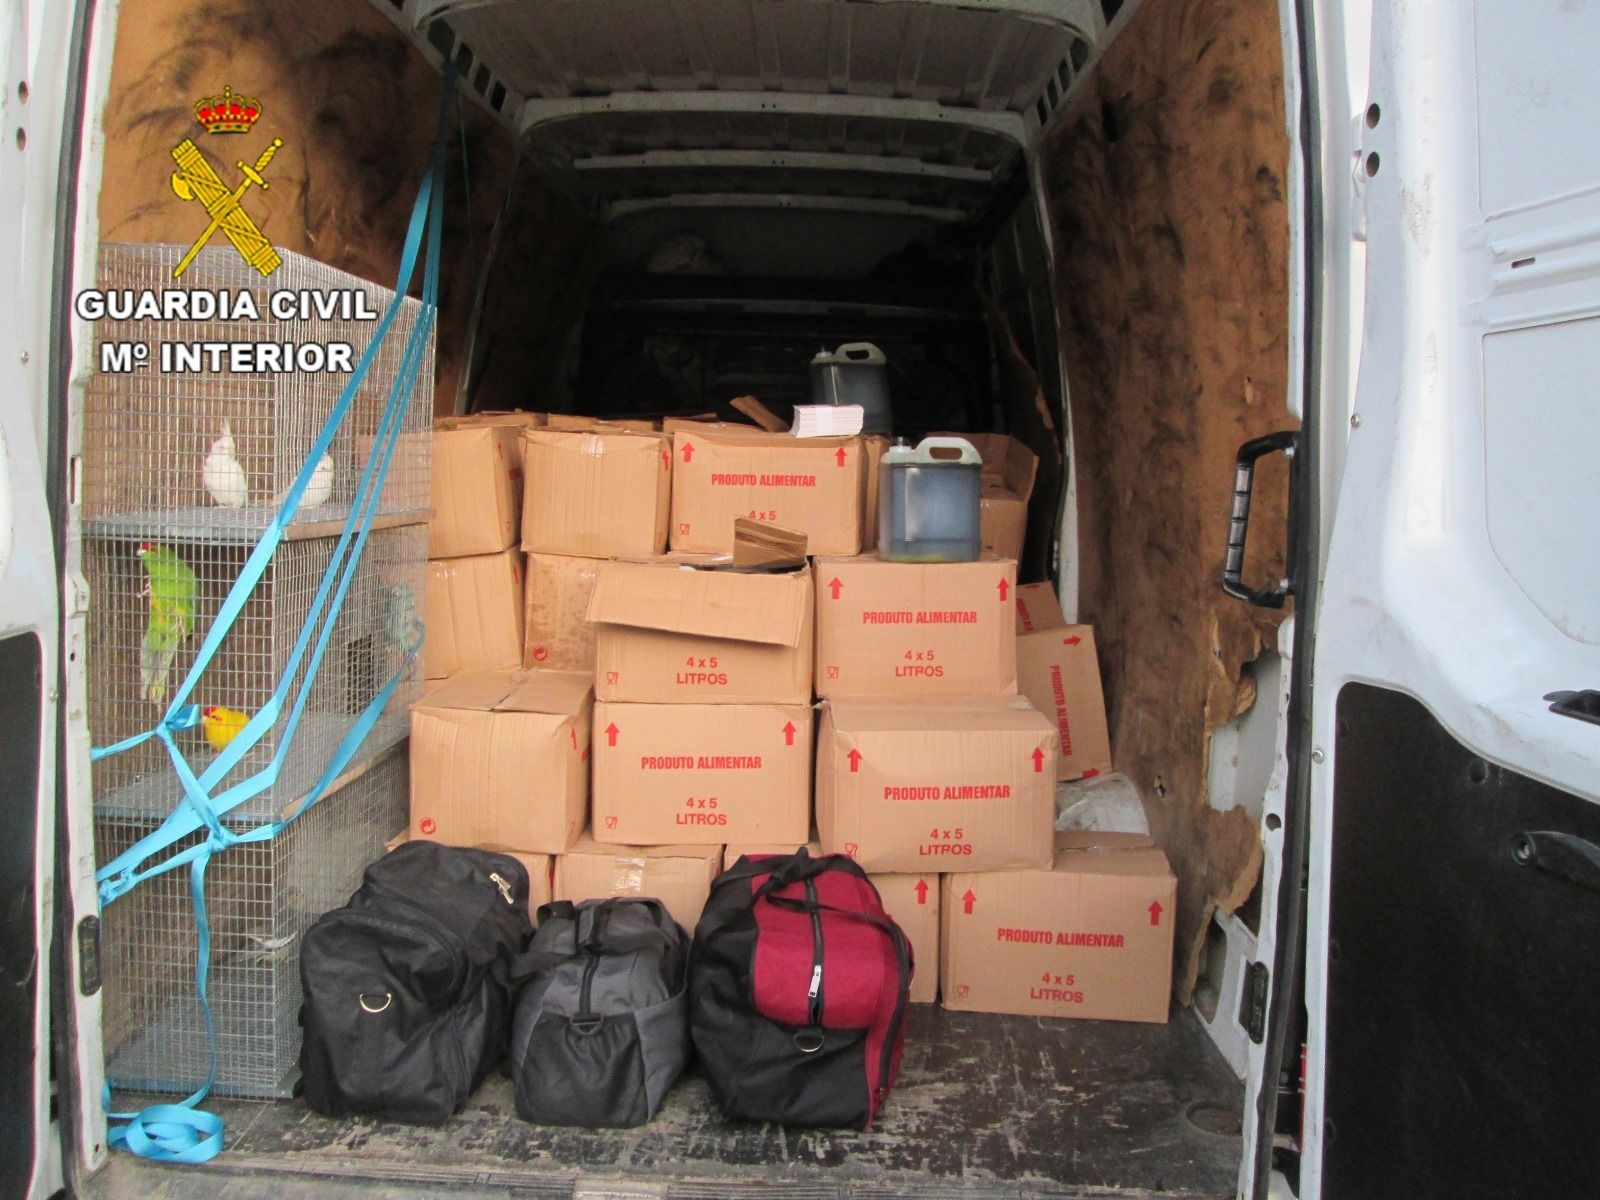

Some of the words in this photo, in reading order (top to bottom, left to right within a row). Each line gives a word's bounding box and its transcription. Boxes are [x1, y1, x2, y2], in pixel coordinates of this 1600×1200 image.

[711, 473, 757, 486] PRODUTO
[759, 474, 816, 487] ALIMENTAR
[748, 509, 757, 521] 4
[759, 511, 767, 522] x
[768, 510, 778, 521] 5
[863, 611, 913, 624] PRODUTO
[916, 611, 977, 624] ALIMENTAR
[686, 656, 696, 669] 4
[698, 658, 706, 669] x
[709, 655, 719, 669] 5
[904, 650, 913, 661] 4
[916, 652, 924, 661] x
[926, 650, 935, 661] 5
[895, 665, 944, 677] LITROS
[676, 672, 728, 685] LITROS
[1050, 665, 1065, 705] PRODUTO
[1056, 708, 1072, 757] ALIMENTAR
[641, 756, 694, 769] PRODUTO
[697, 756, 762, 769] ALIMENTAR
[883, 786, 941, 801] PRODUTO
[943, 785, 1011, 800] ALIMENTAR
[686, 797, 695, 809] 4
[698, 799, 706, 809] x
[709, 797, 718, 809] 5
[676, 812, 728, 826] LITROS
[930, 828, 940, 840] 4
[943, 830, 951, 840] x
[954, 828, 964, 840] 5
[919, 844, 972, 856] LITROS
[997, 927, 1054, 945] PRODUTO
[1056, 931, 1124, 948] ALIMENTAR
[1041, 973, 1051, 985] 4
[1054, 975, 1063, 986] x
[1066, 974, 1075, 987] 5
[1029, 987, 1084, 1004] LITROS
